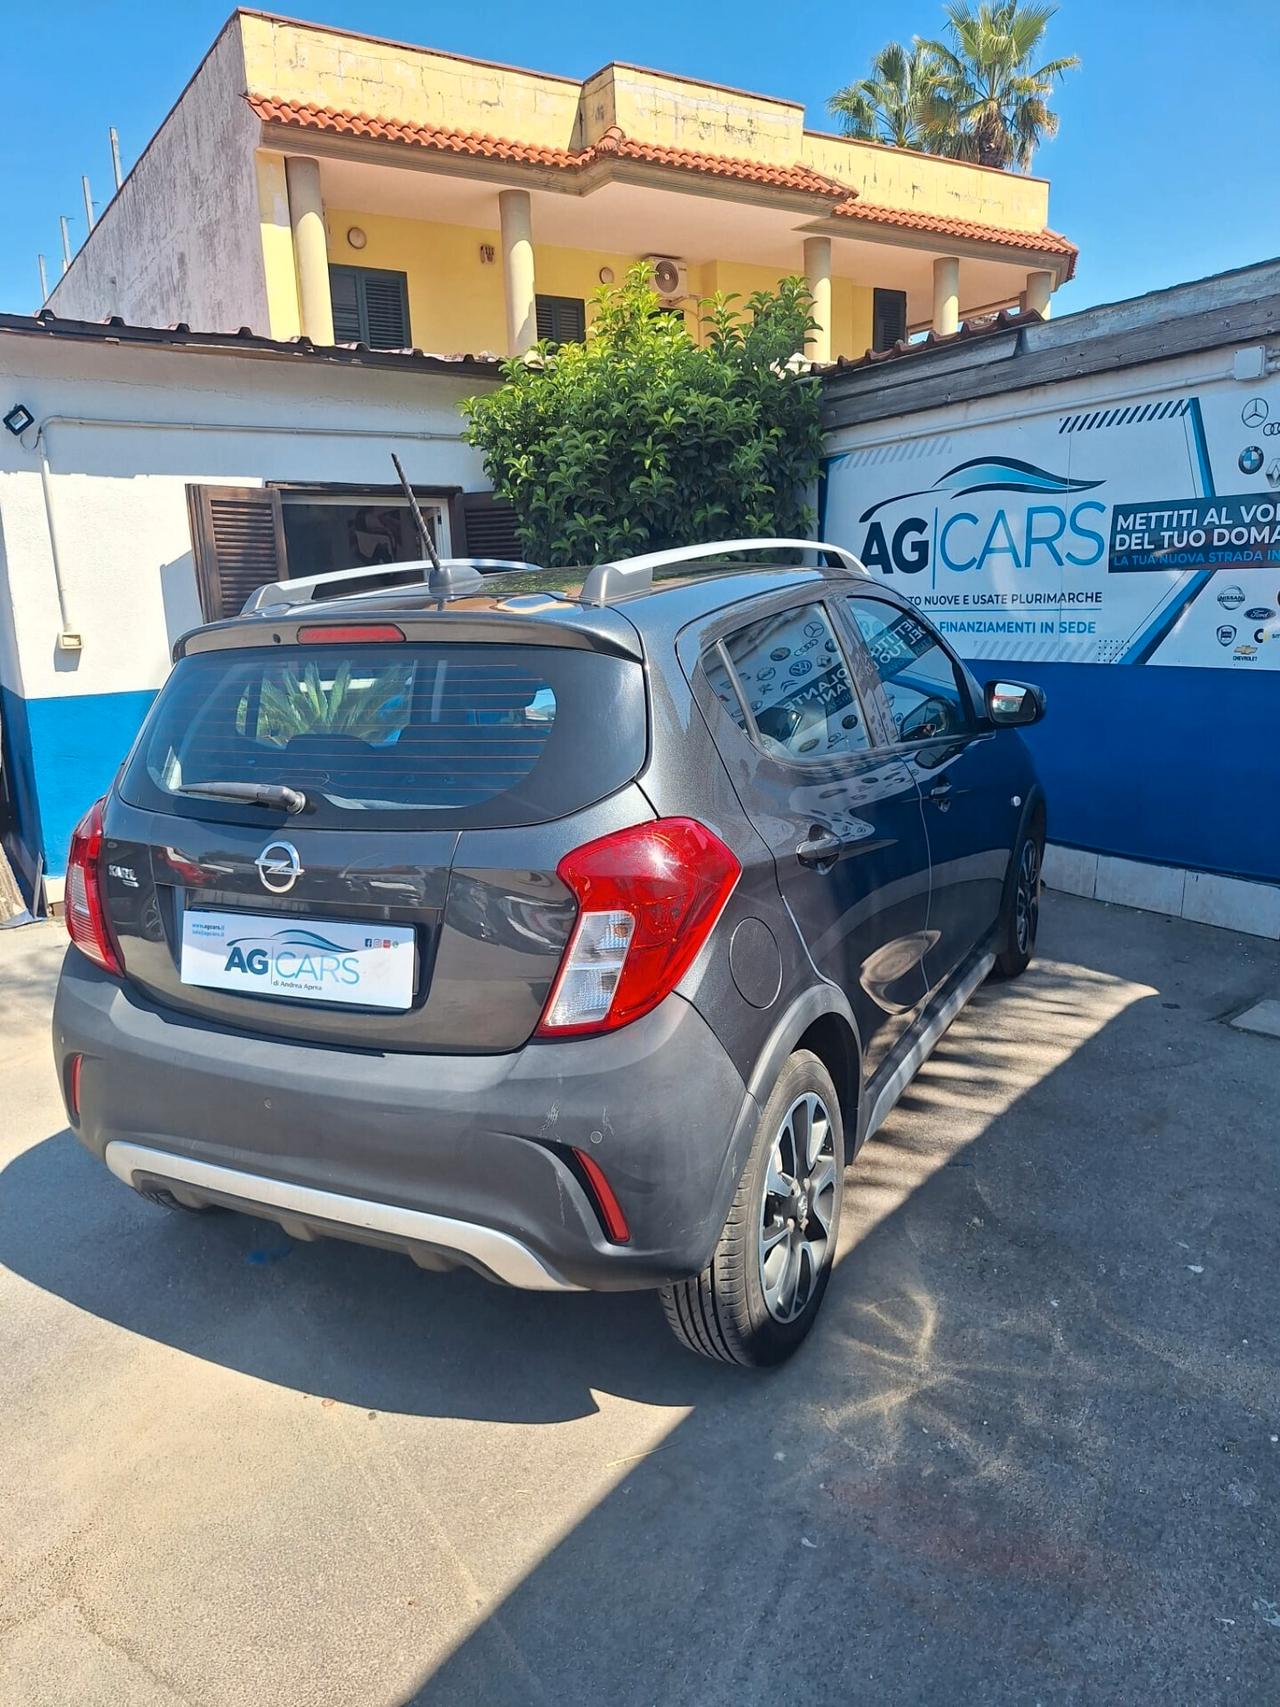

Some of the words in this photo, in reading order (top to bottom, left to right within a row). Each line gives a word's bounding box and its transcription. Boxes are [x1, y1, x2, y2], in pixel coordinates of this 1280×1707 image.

[1116, 508, 1198, 531] METTITI
[1203, 507, 1233, 526] AL
[860, 517, 930, 575] AG
[940, 501, 1107, 573] CARS
[1115, 532, 1155, 551] DEL
[1160, 529, 1206, 549] TUO
[1213, 525, 1280, 547] DOMA
[1114, 556, 1129, 566] LA
[1132, 554, 1155, 566] TUA
[1159, 552, 1205, 565] NUOVA
[1209, 550, 1263, 563] STRADA
[924, 594, 961, 606] NUOVE
[963, 595, 970, 605] E
[972, 593, 1008, 606] USATE
[1011, 591, 1103, 605] PLURIMARCHE
[939, 621, 1036, 634] FINANZIAMENTI
[1040, 621, 1054, 634] IN
[1059, 621, 1096, 634] SEDE
[224, 947, 269, 976] AG
[274, 951, 360, 985] CARS
[280, 981, 303, 989] Andrea
